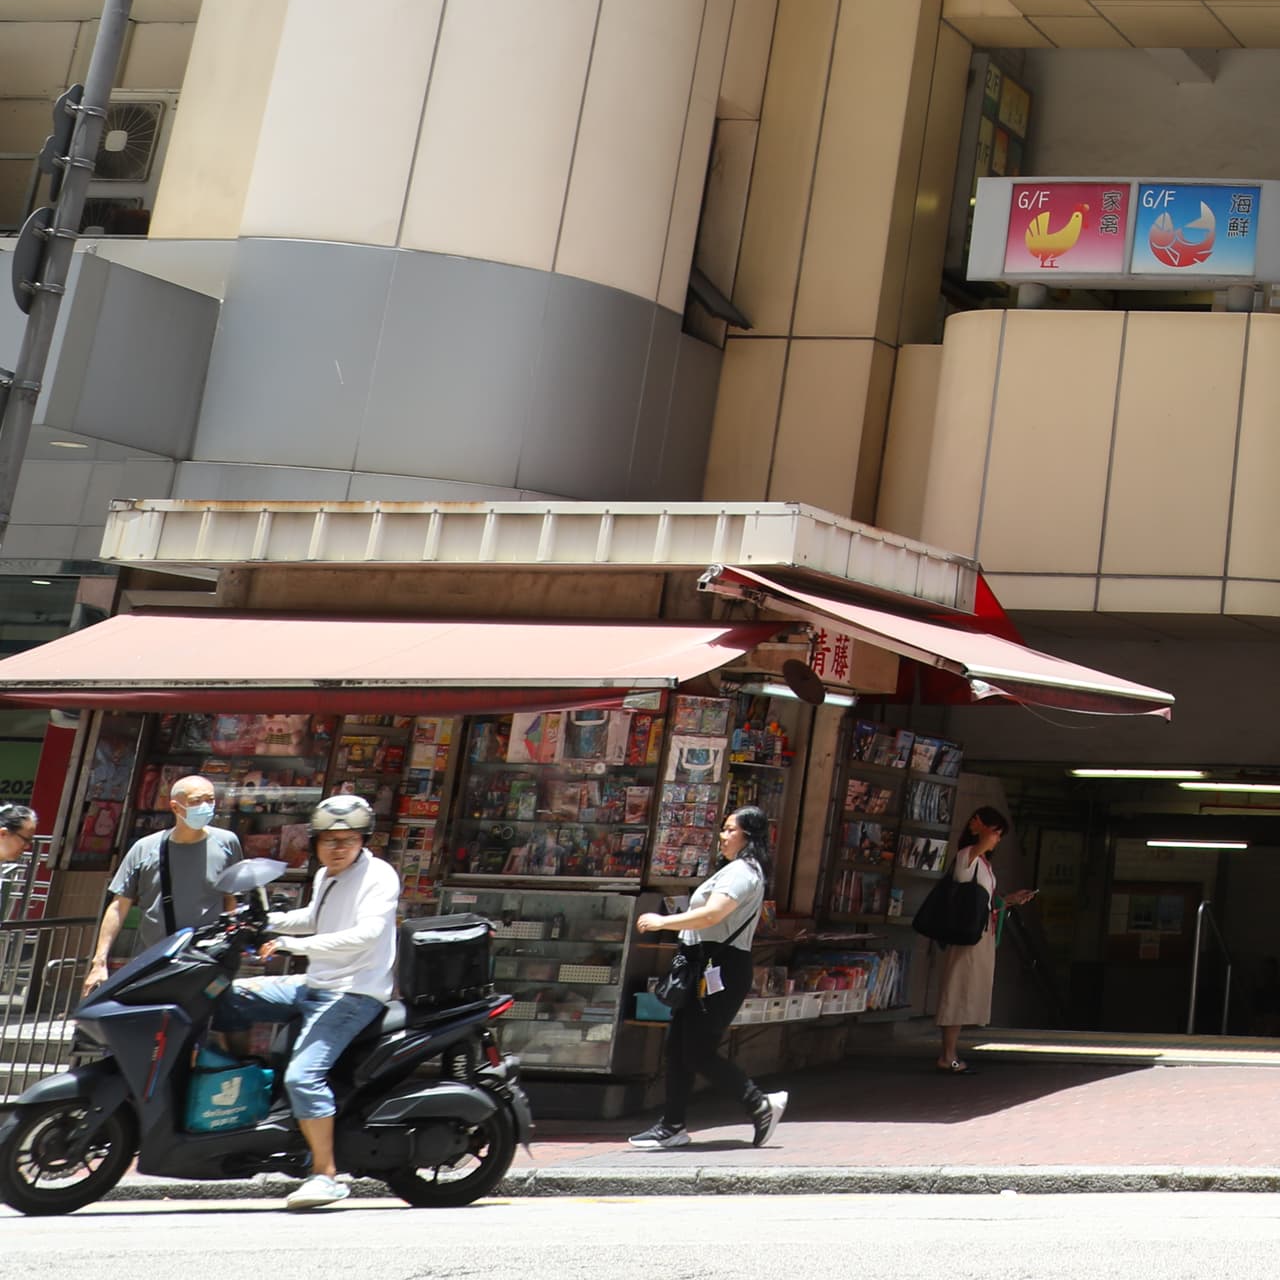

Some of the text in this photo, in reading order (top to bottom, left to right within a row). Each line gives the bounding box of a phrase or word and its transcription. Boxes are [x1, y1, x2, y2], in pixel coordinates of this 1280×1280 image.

[1018, 190, 1051, 209] G/F
[1099, 189, 1122, 235] 家禽
[1142, 189, 1176, 208] G/F
[1227, 193, 1253, 238] 海鮮
